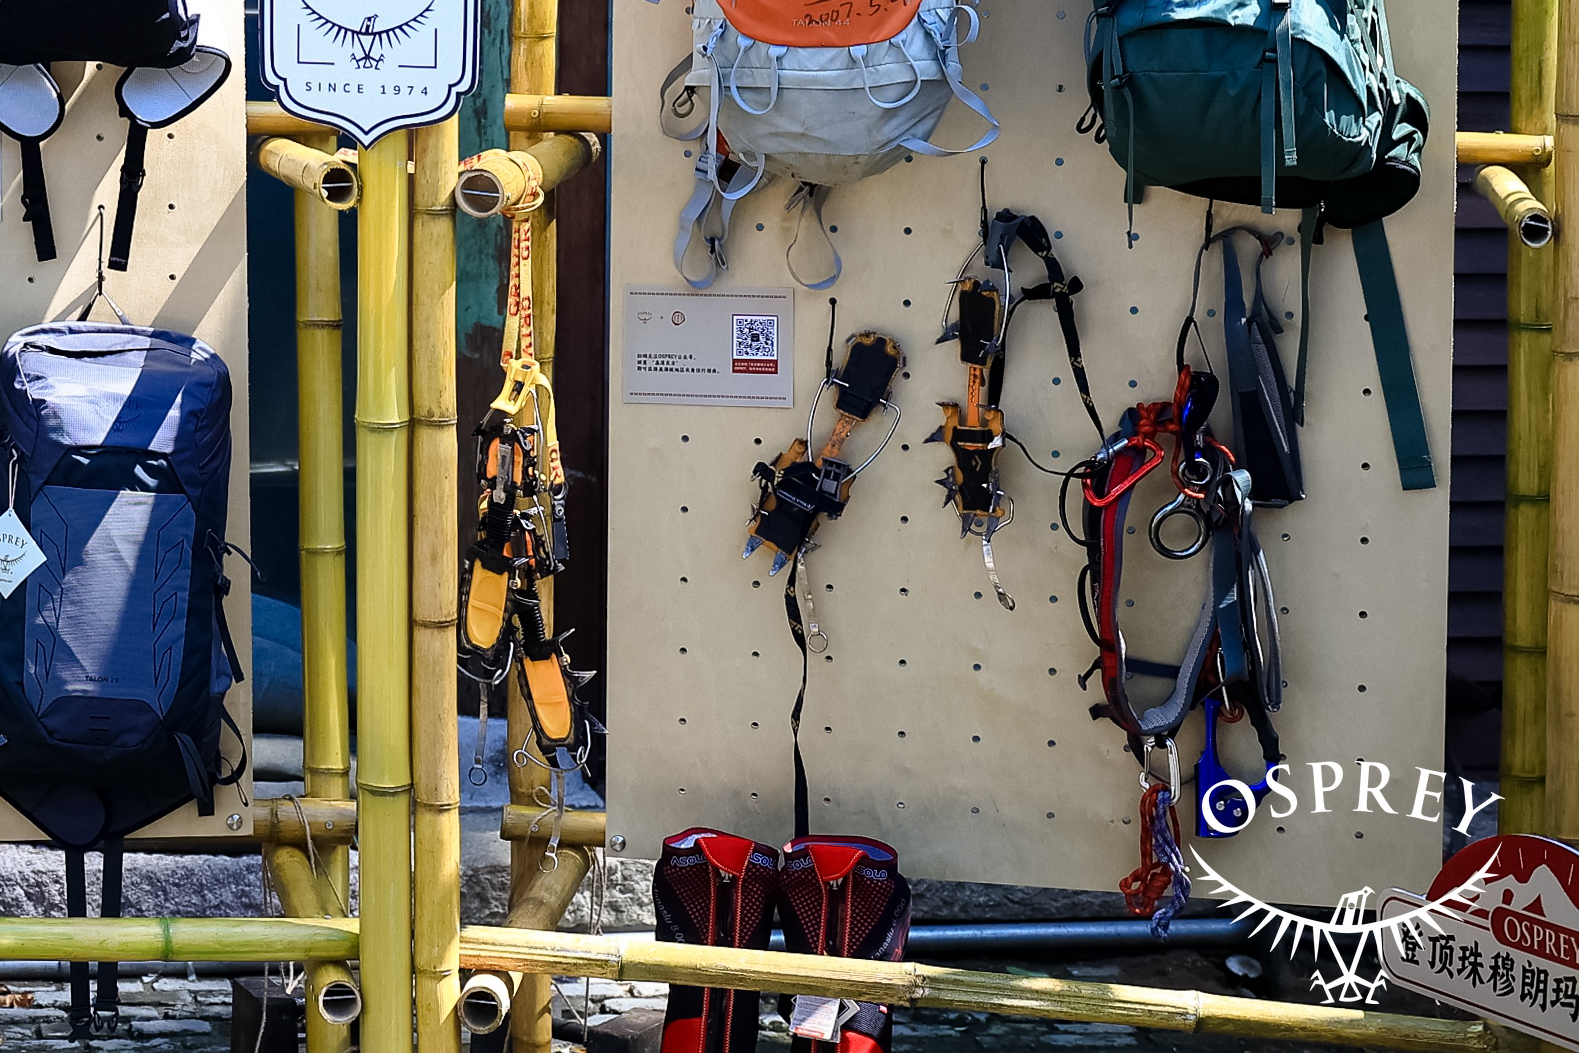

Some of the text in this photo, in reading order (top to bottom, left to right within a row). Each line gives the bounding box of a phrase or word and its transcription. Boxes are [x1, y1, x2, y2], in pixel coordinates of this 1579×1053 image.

[835, 18, 851, 26] 44
[305, 81, 430, 96] SINCE 1974
[84, 675, 108, 684] TALON
